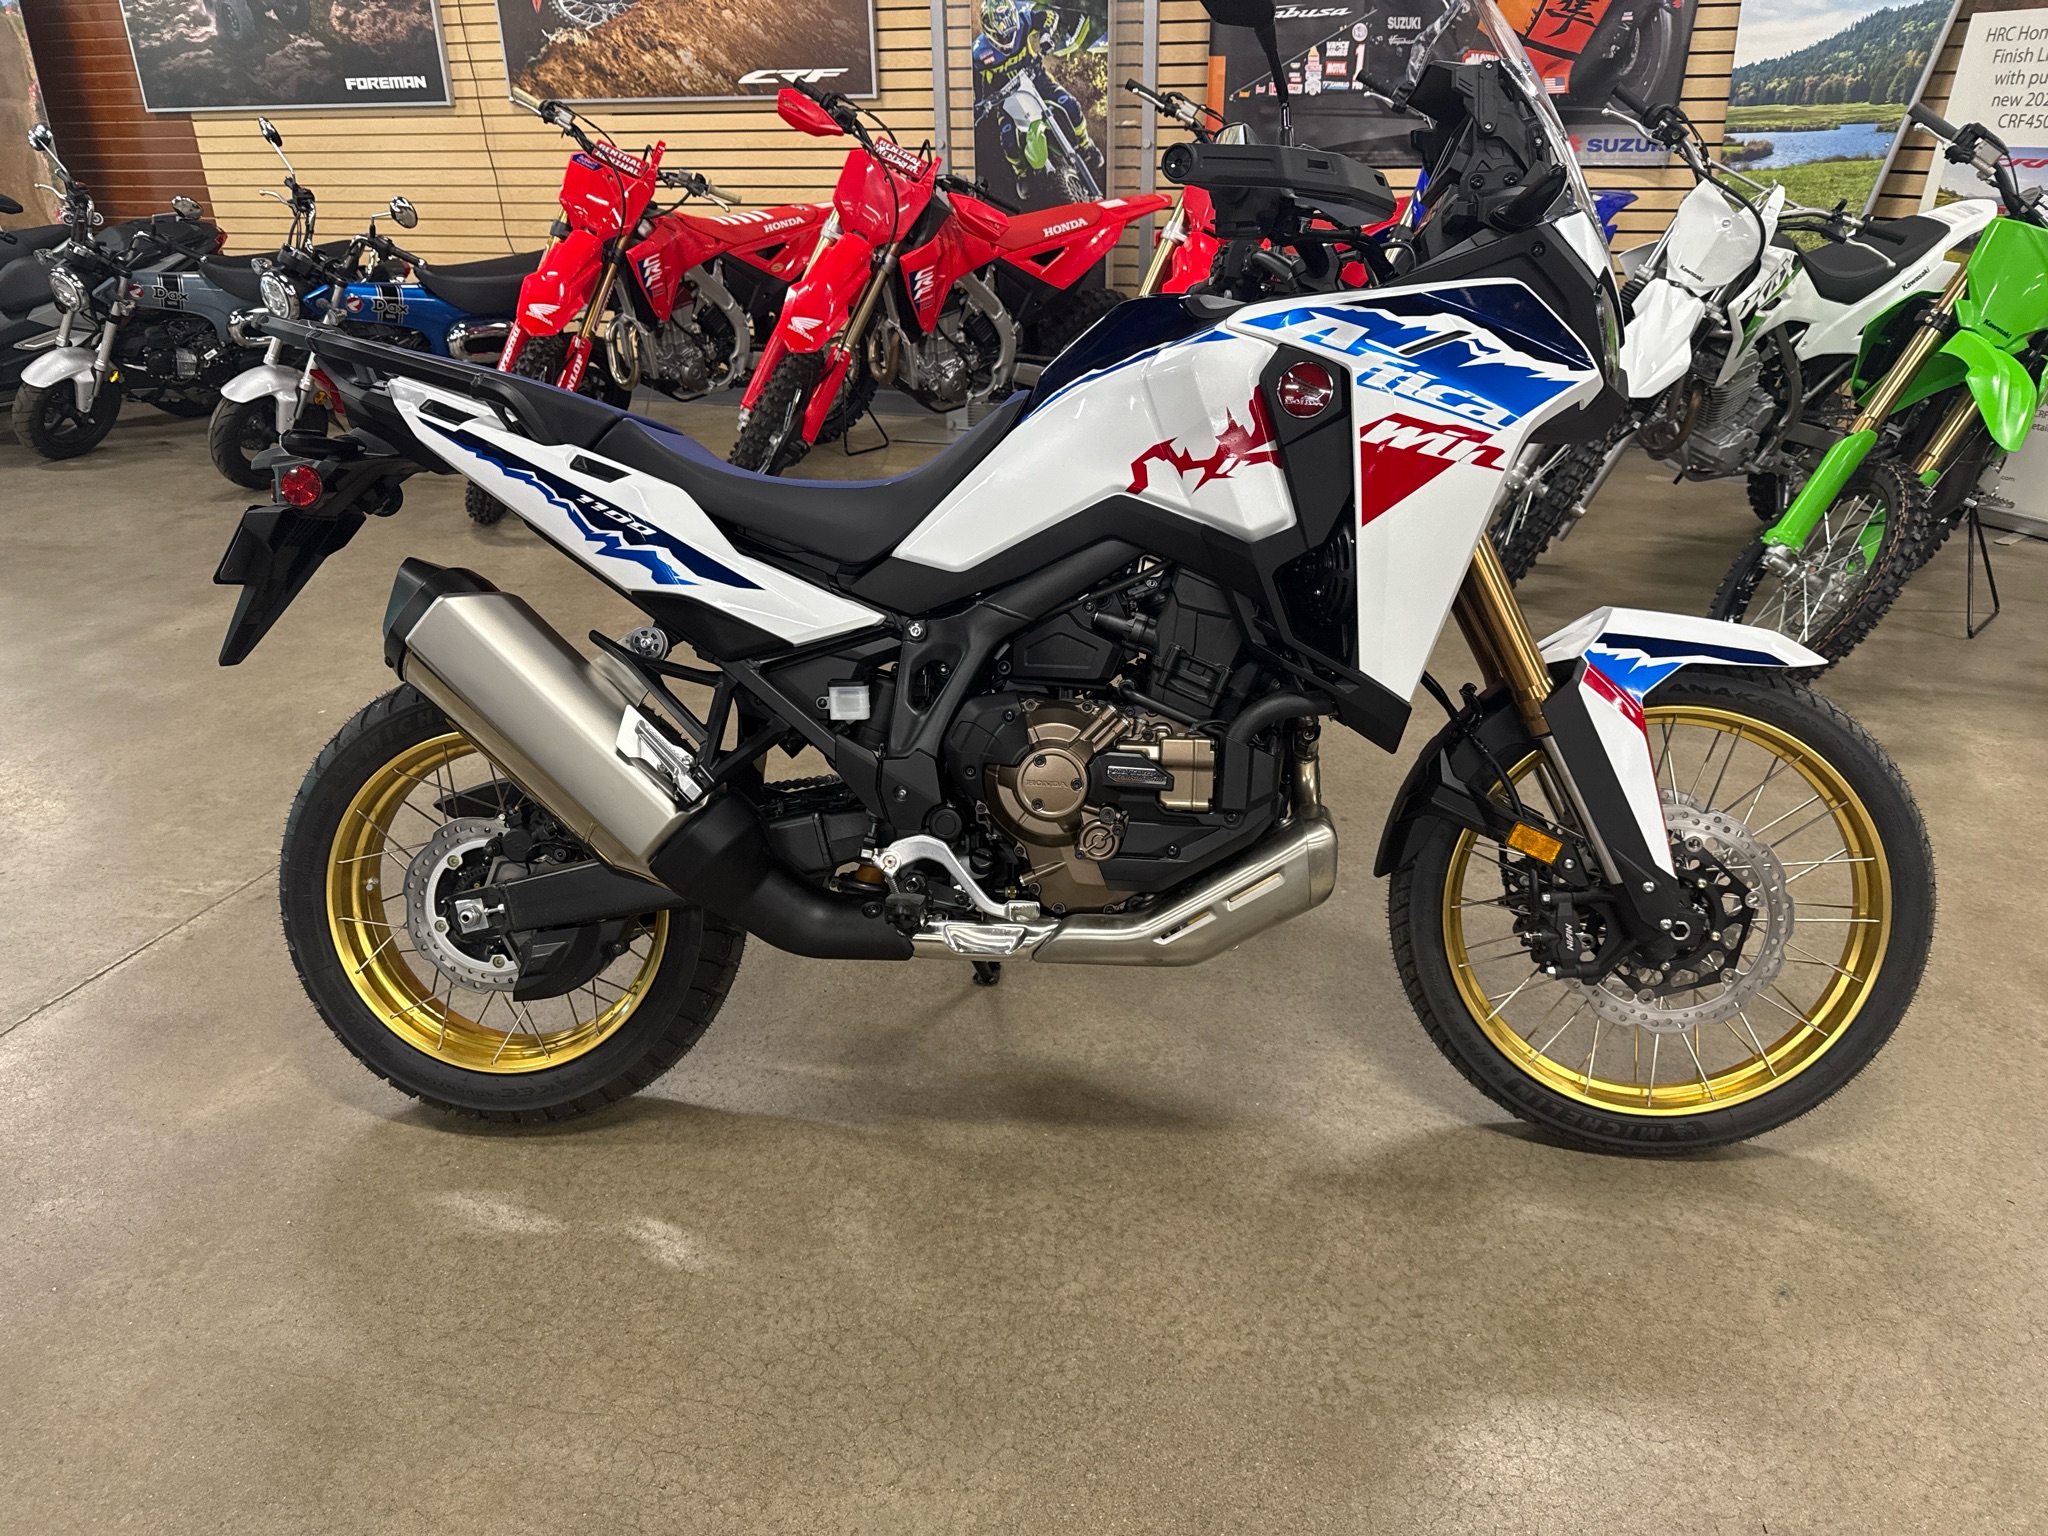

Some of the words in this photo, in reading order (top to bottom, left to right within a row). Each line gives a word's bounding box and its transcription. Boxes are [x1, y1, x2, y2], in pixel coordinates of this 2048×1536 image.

[1388, 17, 1421, 29] SUZUKI
[1986, 26, 2017, 42] HRC
[1993, 47, 2034, 63] Finish
[344, 76, 427, 90] FOREMAN
[1995, 69, 2026, 86] with
[1991, 95, 2023, 107] new
[763, 216, 805, 233] HONDA
[1042, 217, 1088, 237] HONDA
[1680, 264, 1705, 283] Kawasaki
[1901, 266, 1931, 291] Kawasaki
[152, 286, 189, 301] Dax
[371, 298, 409, 314] Dax
[787, 323, 814, 343] HONDA
[1983, 318, 2012, 340] Kawasaki
[576, 494, 657, 536] 1100
[1026, 780, 1068, 788] HONDA
